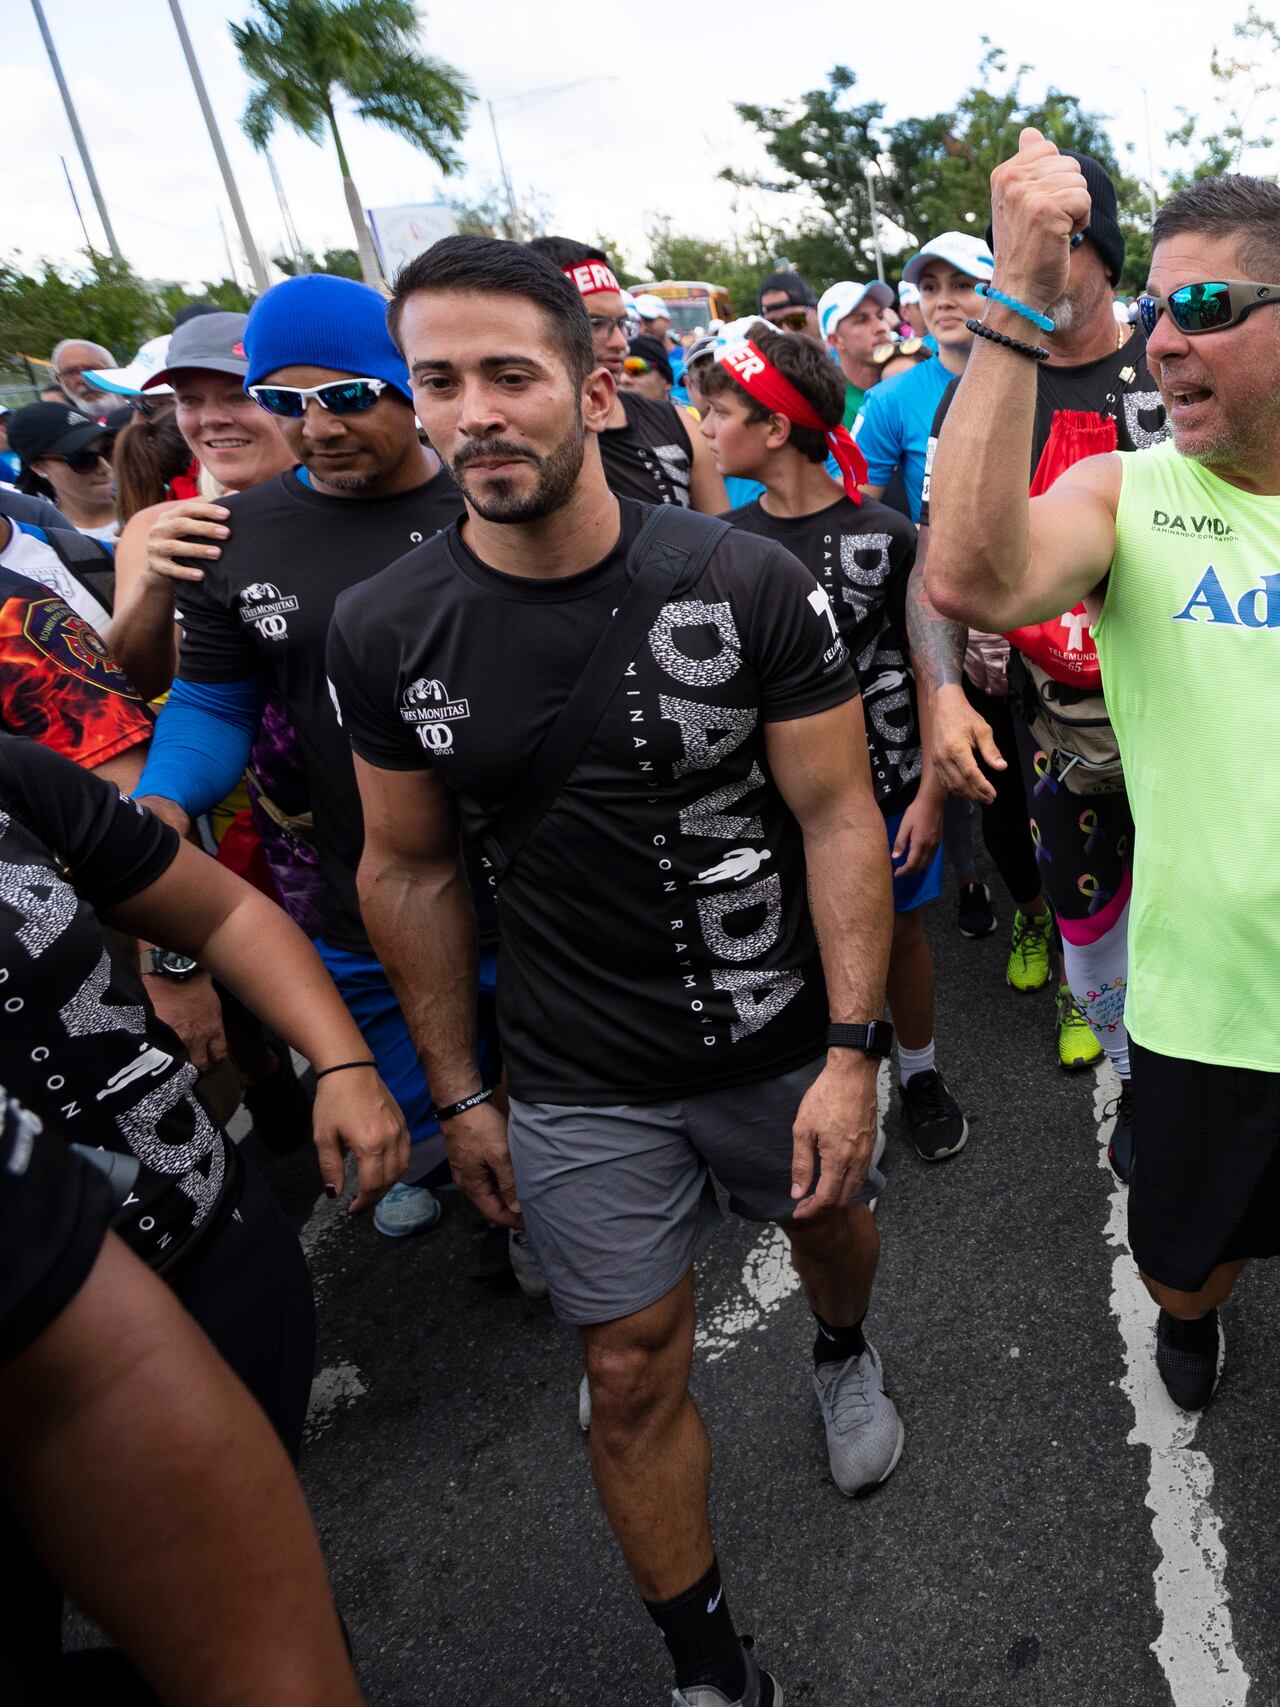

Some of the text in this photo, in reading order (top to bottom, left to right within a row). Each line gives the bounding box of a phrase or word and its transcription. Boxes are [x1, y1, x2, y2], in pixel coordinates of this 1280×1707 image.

[1151, 525, 1196, 539] CAMINANDO
[242, 599, 295, 620] TRES MONJITAS
[254, 614, 288, 639] 100
[1048, 646, 1100, 661] TELEMUND
[1068, 661, 1083, 673] 65
[400, 704, 465, 721] TRES MONJITAS
[415, 723, 454, 750] 100
[653, 834, 677, 893] CON
[31, 1045, 82, 1121] CON
